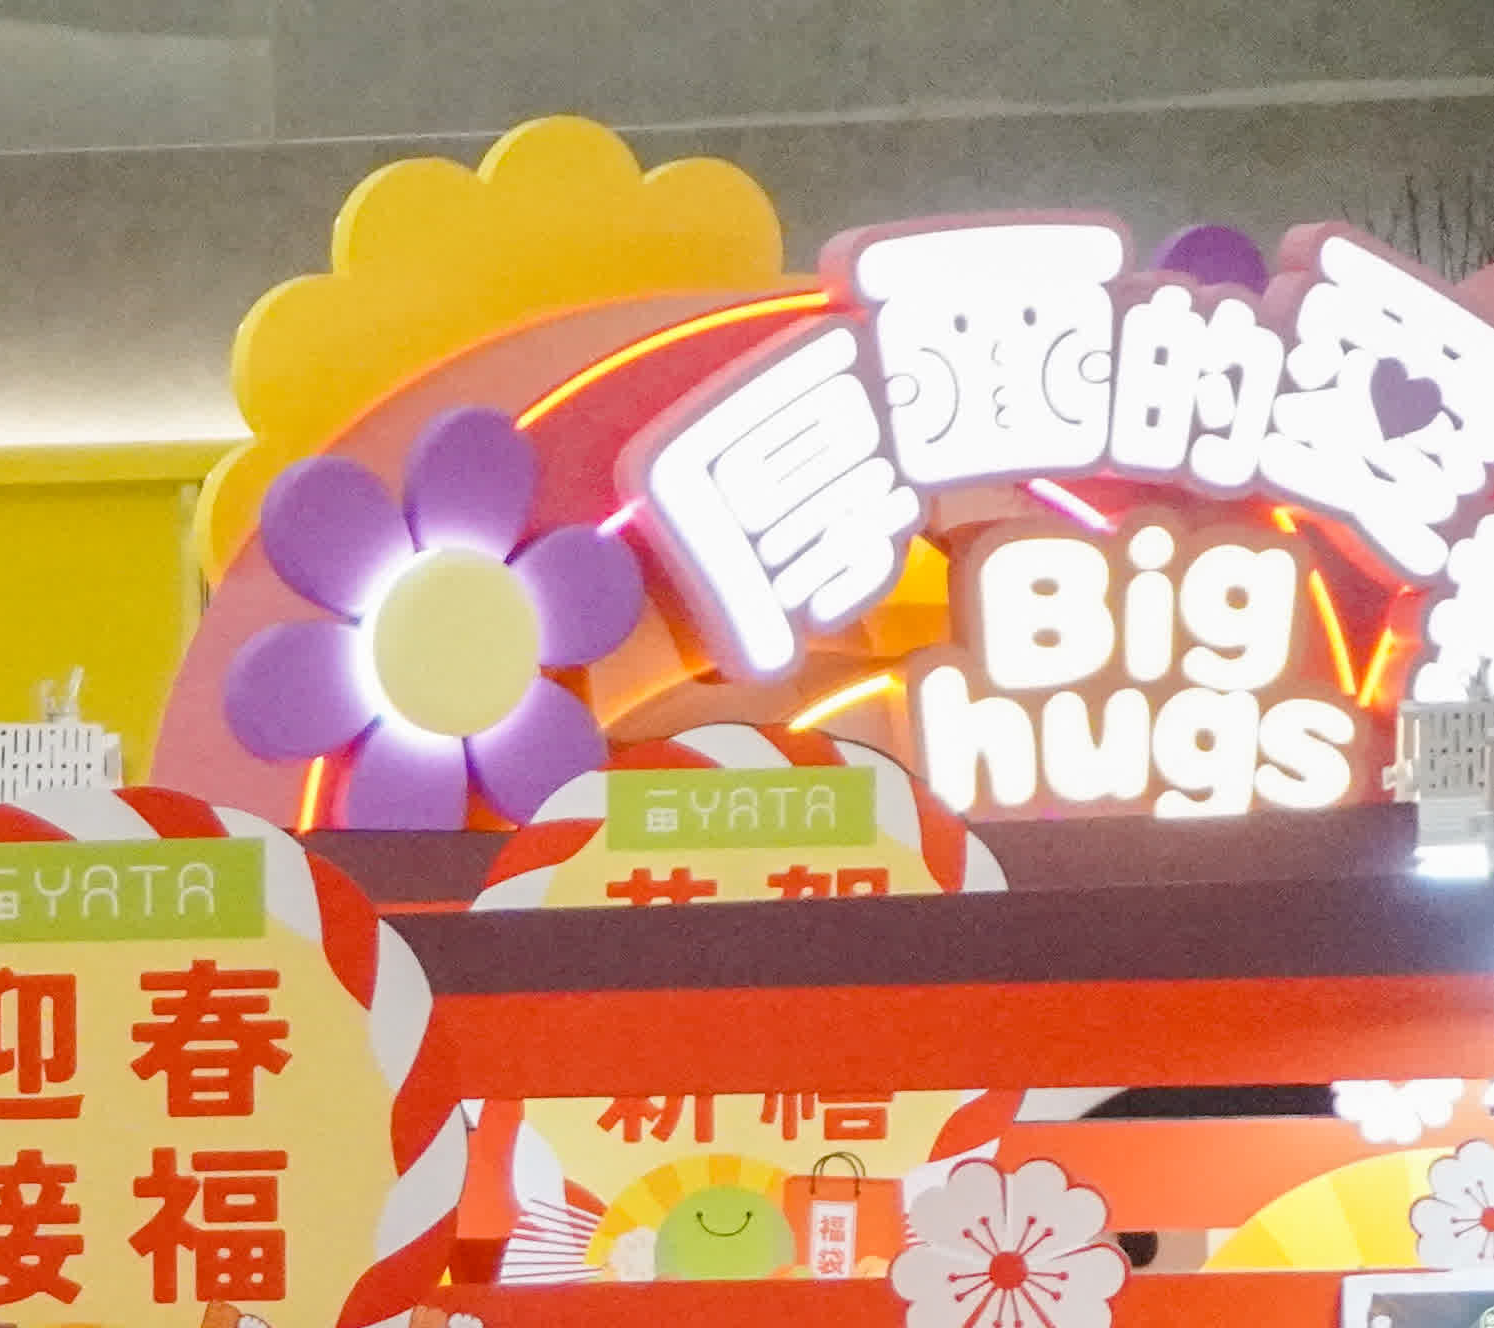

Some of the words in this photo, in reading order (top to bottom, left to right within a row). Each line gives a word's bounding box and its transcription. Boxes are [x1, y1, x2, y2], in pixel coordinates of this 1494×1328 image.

[981, 525, 1297, 690] Big
[922, 662, 1357, 819] hugs
[691, 785, 837, 834] YATA
[32, 861, 217, 921] YATA
